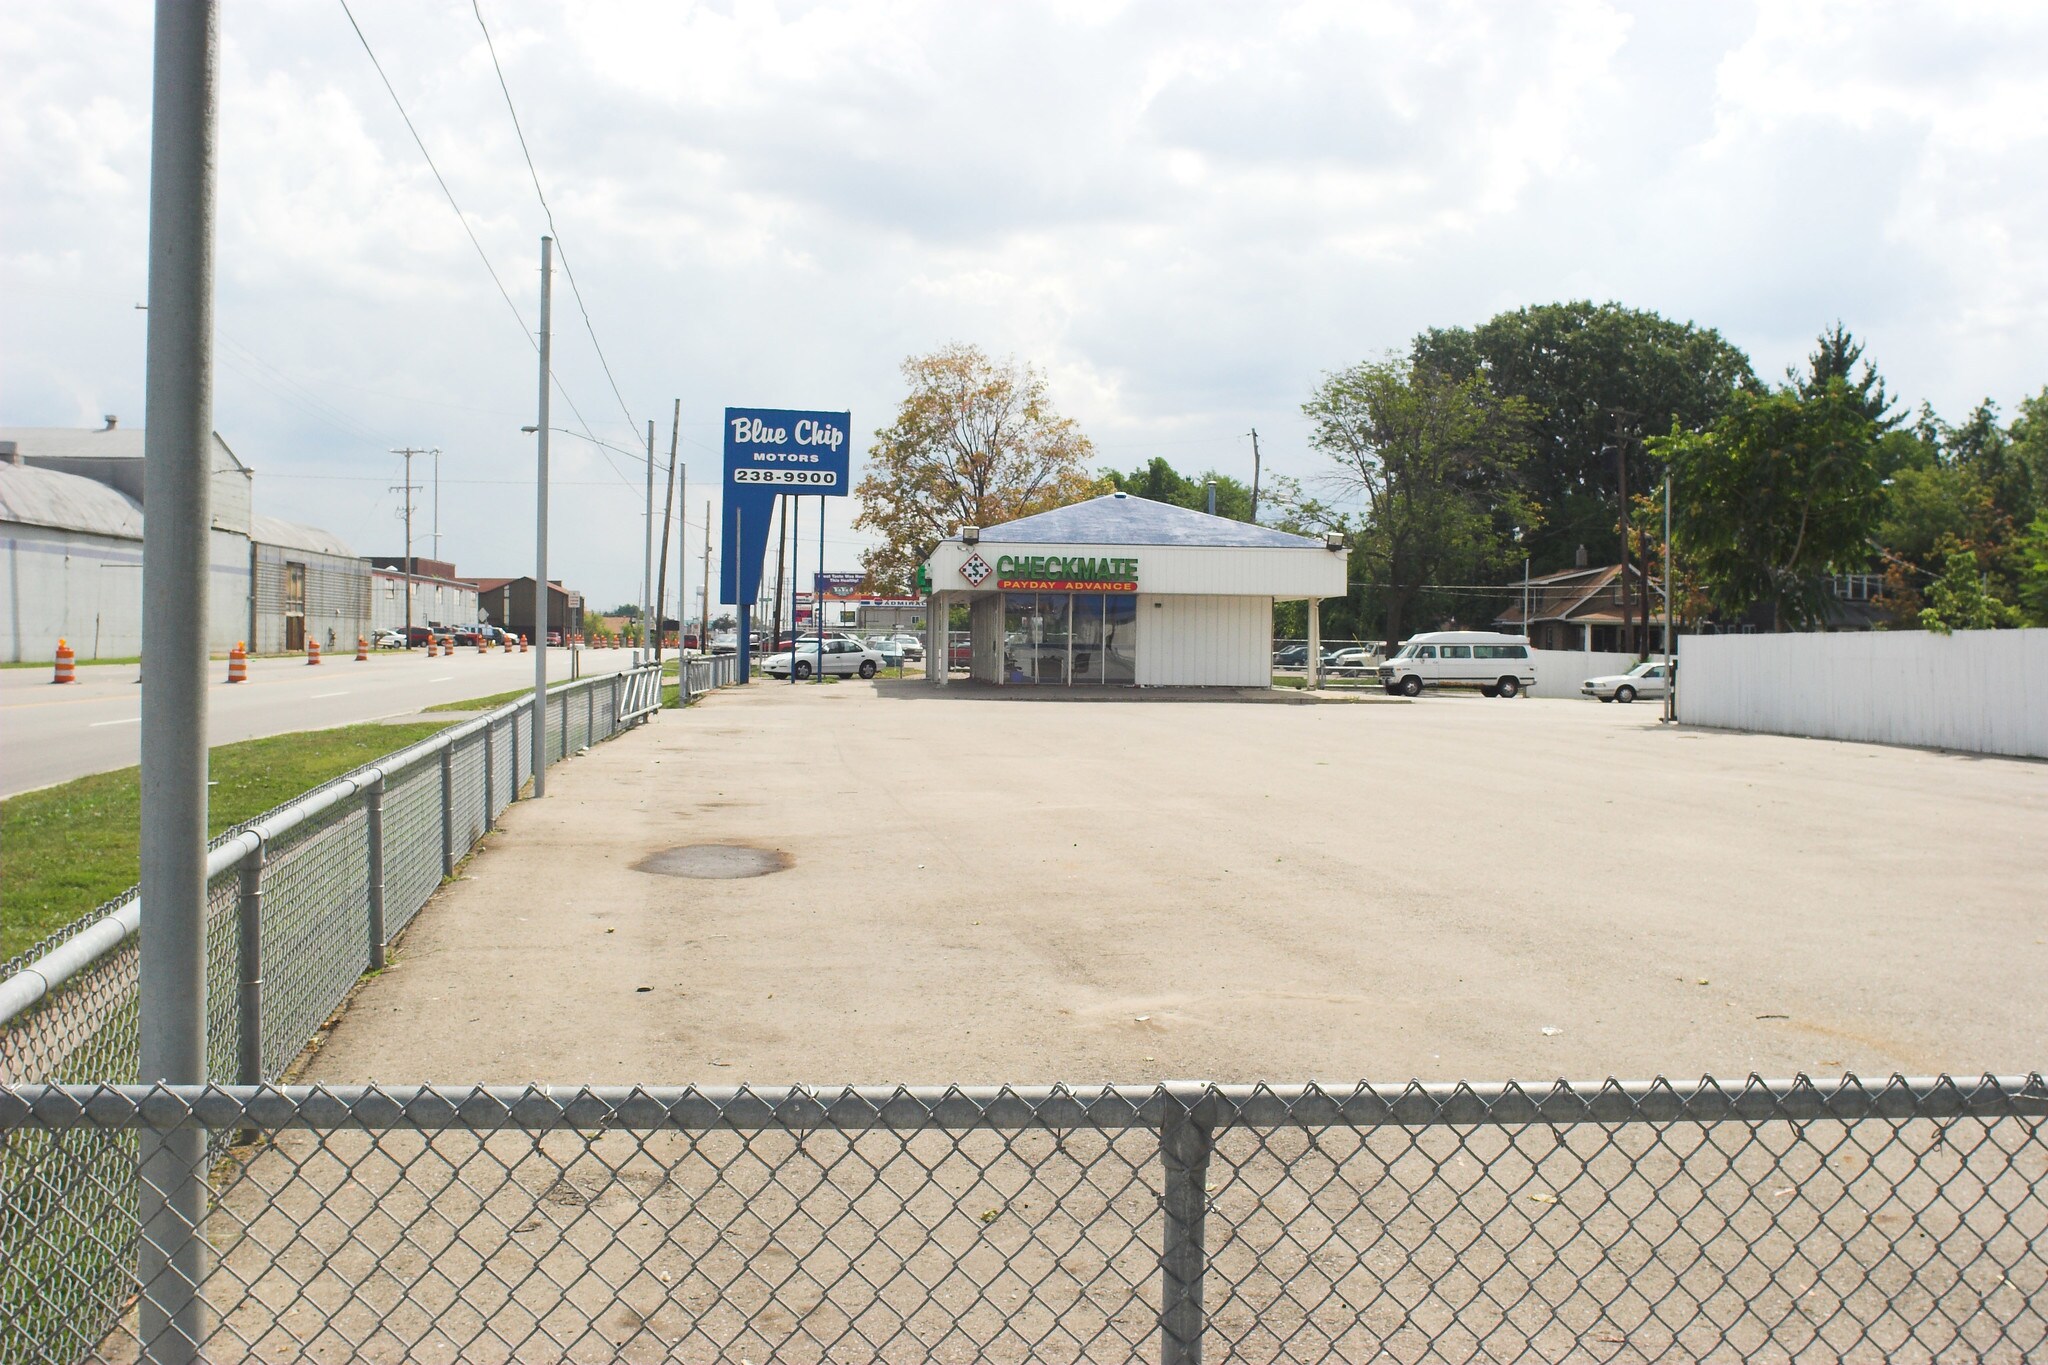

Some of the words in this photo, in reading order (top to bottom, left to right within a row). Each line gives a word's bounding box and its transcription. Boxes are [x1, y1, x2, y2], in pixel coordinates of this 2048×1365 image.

[731, 417, 788, 445] Blue
[794, 419, 844, 452] Chip
[753, 452, 819, 463] MOTORS
[736, 470, 835, 483] 238-9900
[996, 555, 1139, 581] CHECKMATE
[1003, 581, 1056, 590] PAYDAY
[1065, 582, 1132, 591] ADVANCE
